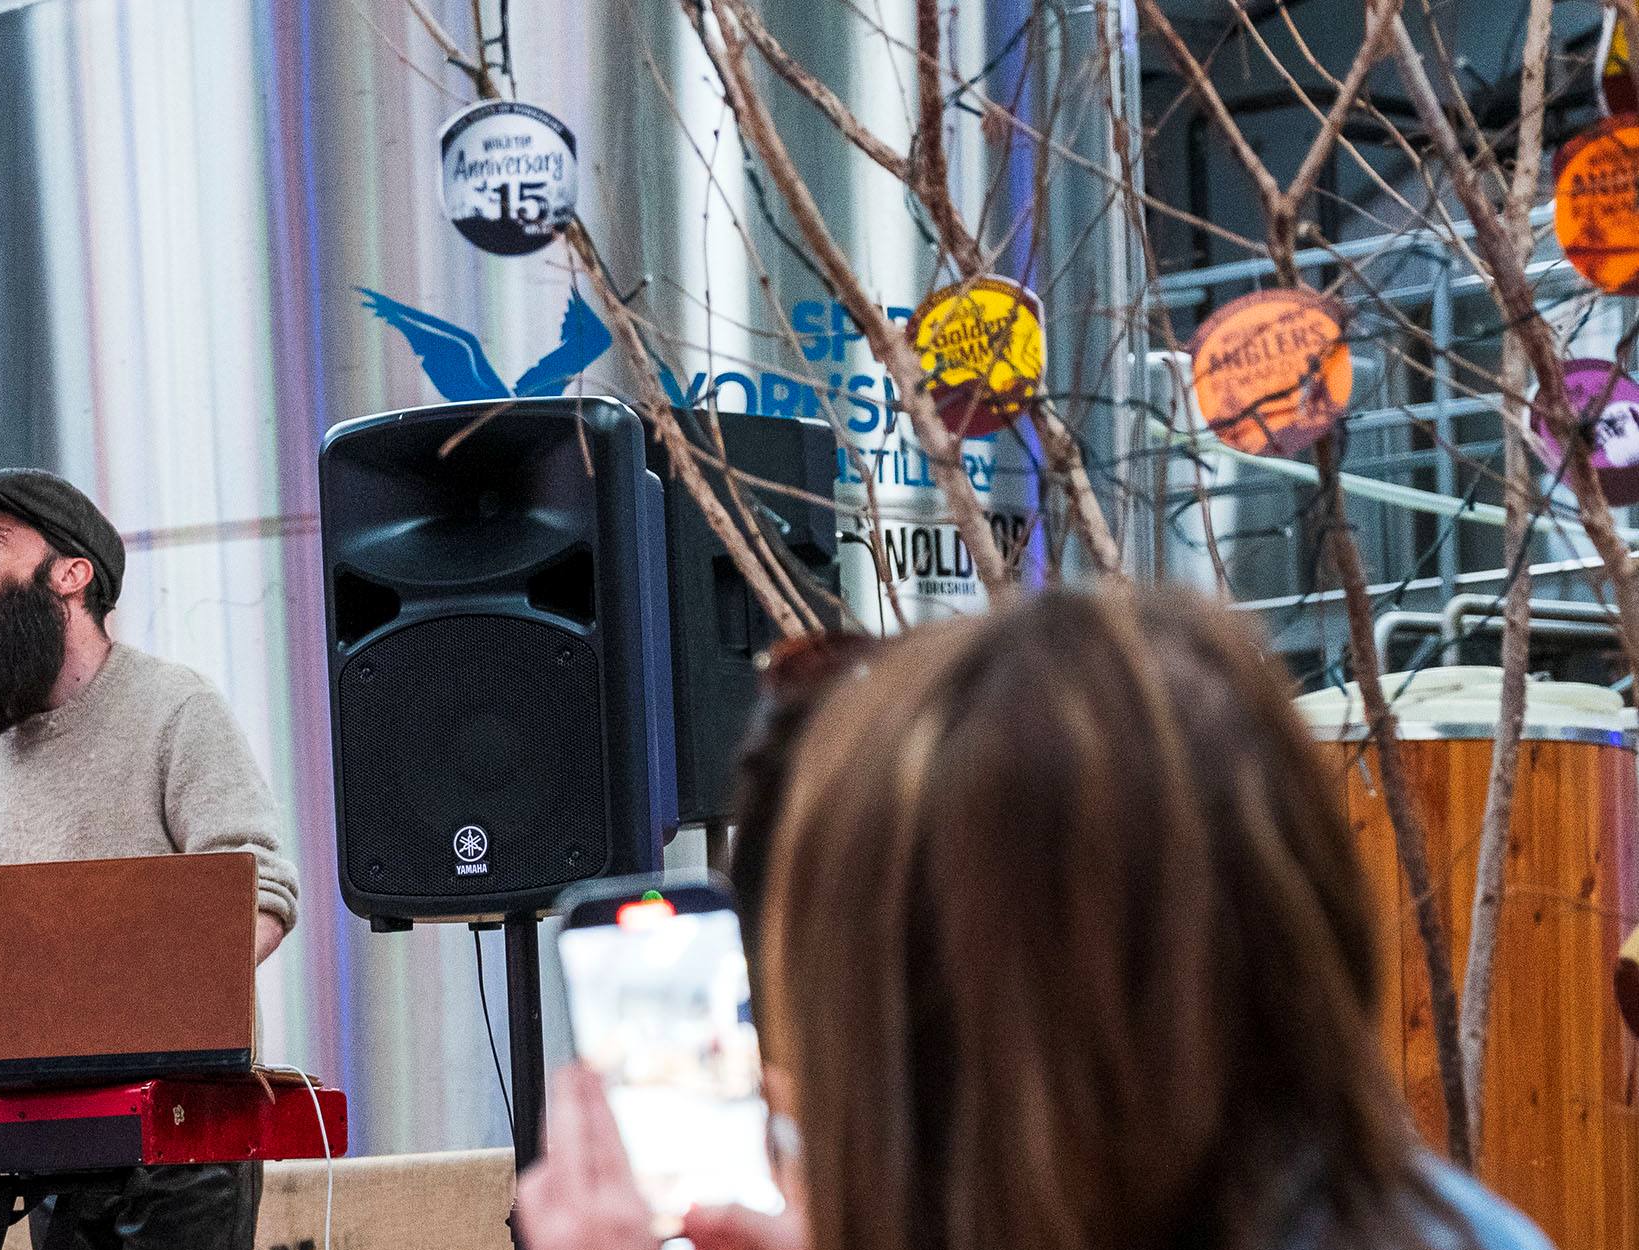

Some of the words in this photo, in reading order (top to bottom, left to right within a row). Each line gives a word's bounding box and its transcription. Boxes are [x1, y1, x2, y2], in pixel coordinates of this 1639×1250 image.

[453, 150, 564, 181] Anniversary
[1208, 322, 1327, 373] ANGLERS
[456, 863, 488, 875] YAMAHA
